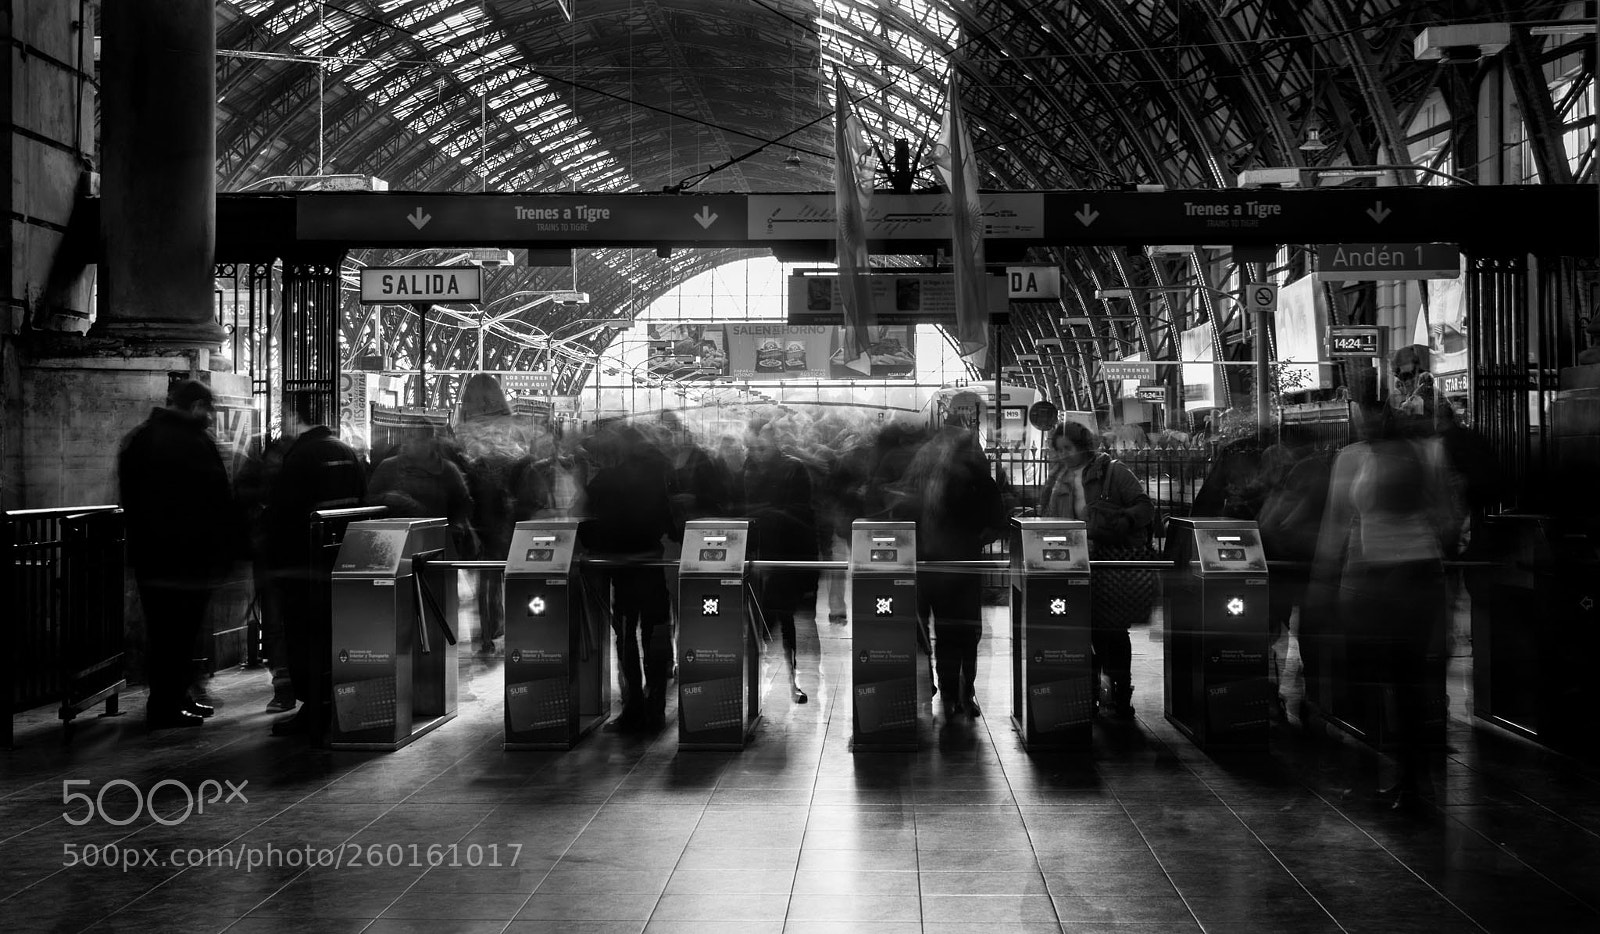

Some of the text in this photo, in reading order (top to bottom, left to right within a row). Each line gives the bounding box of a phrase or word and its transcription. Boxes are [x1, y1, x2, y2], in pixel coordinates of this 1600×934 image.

[515, 205, 610, 222] Trenes a Tigre
[1184, 201, 1282, 218] Trenes a Tigre
[537, 223, 589, 231] TRAINS TO TIGRE
[1332, 245, 1423, 266] Andén 1
[382, 274, 460, 295] SALIDA
[733, 325, 771, 335] SALEN
[782, 324, 825, 335] HORNO
[1334, 338, 1361, 349] 14:24
[358, 373, 366, 408] GOMITAS
[337, 686, 356, 695] SUBE
[510, 686, 528, 695] SUBE
[684, 686, 702, 695] SUBE
